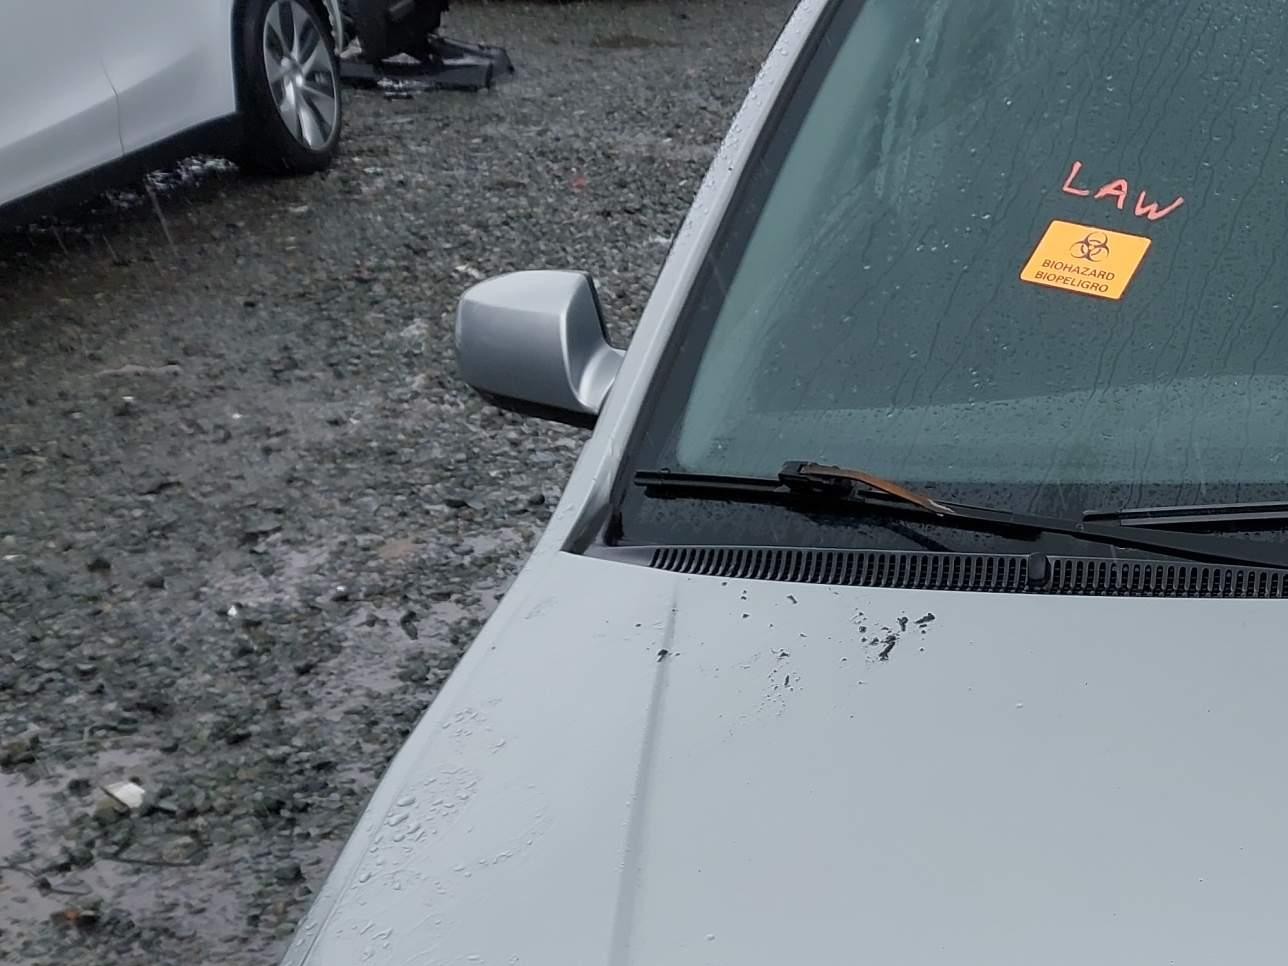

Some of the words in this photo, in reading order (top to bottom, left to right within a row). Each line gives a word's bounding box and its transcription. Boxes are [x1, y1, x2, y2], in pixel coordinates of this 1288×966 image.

[1061, 160, 1185, 221] LAW
[1034, 269, 1109, 294] BIOPELIGRO
[1041, 257, 1115, 281] BIOHAZARD
